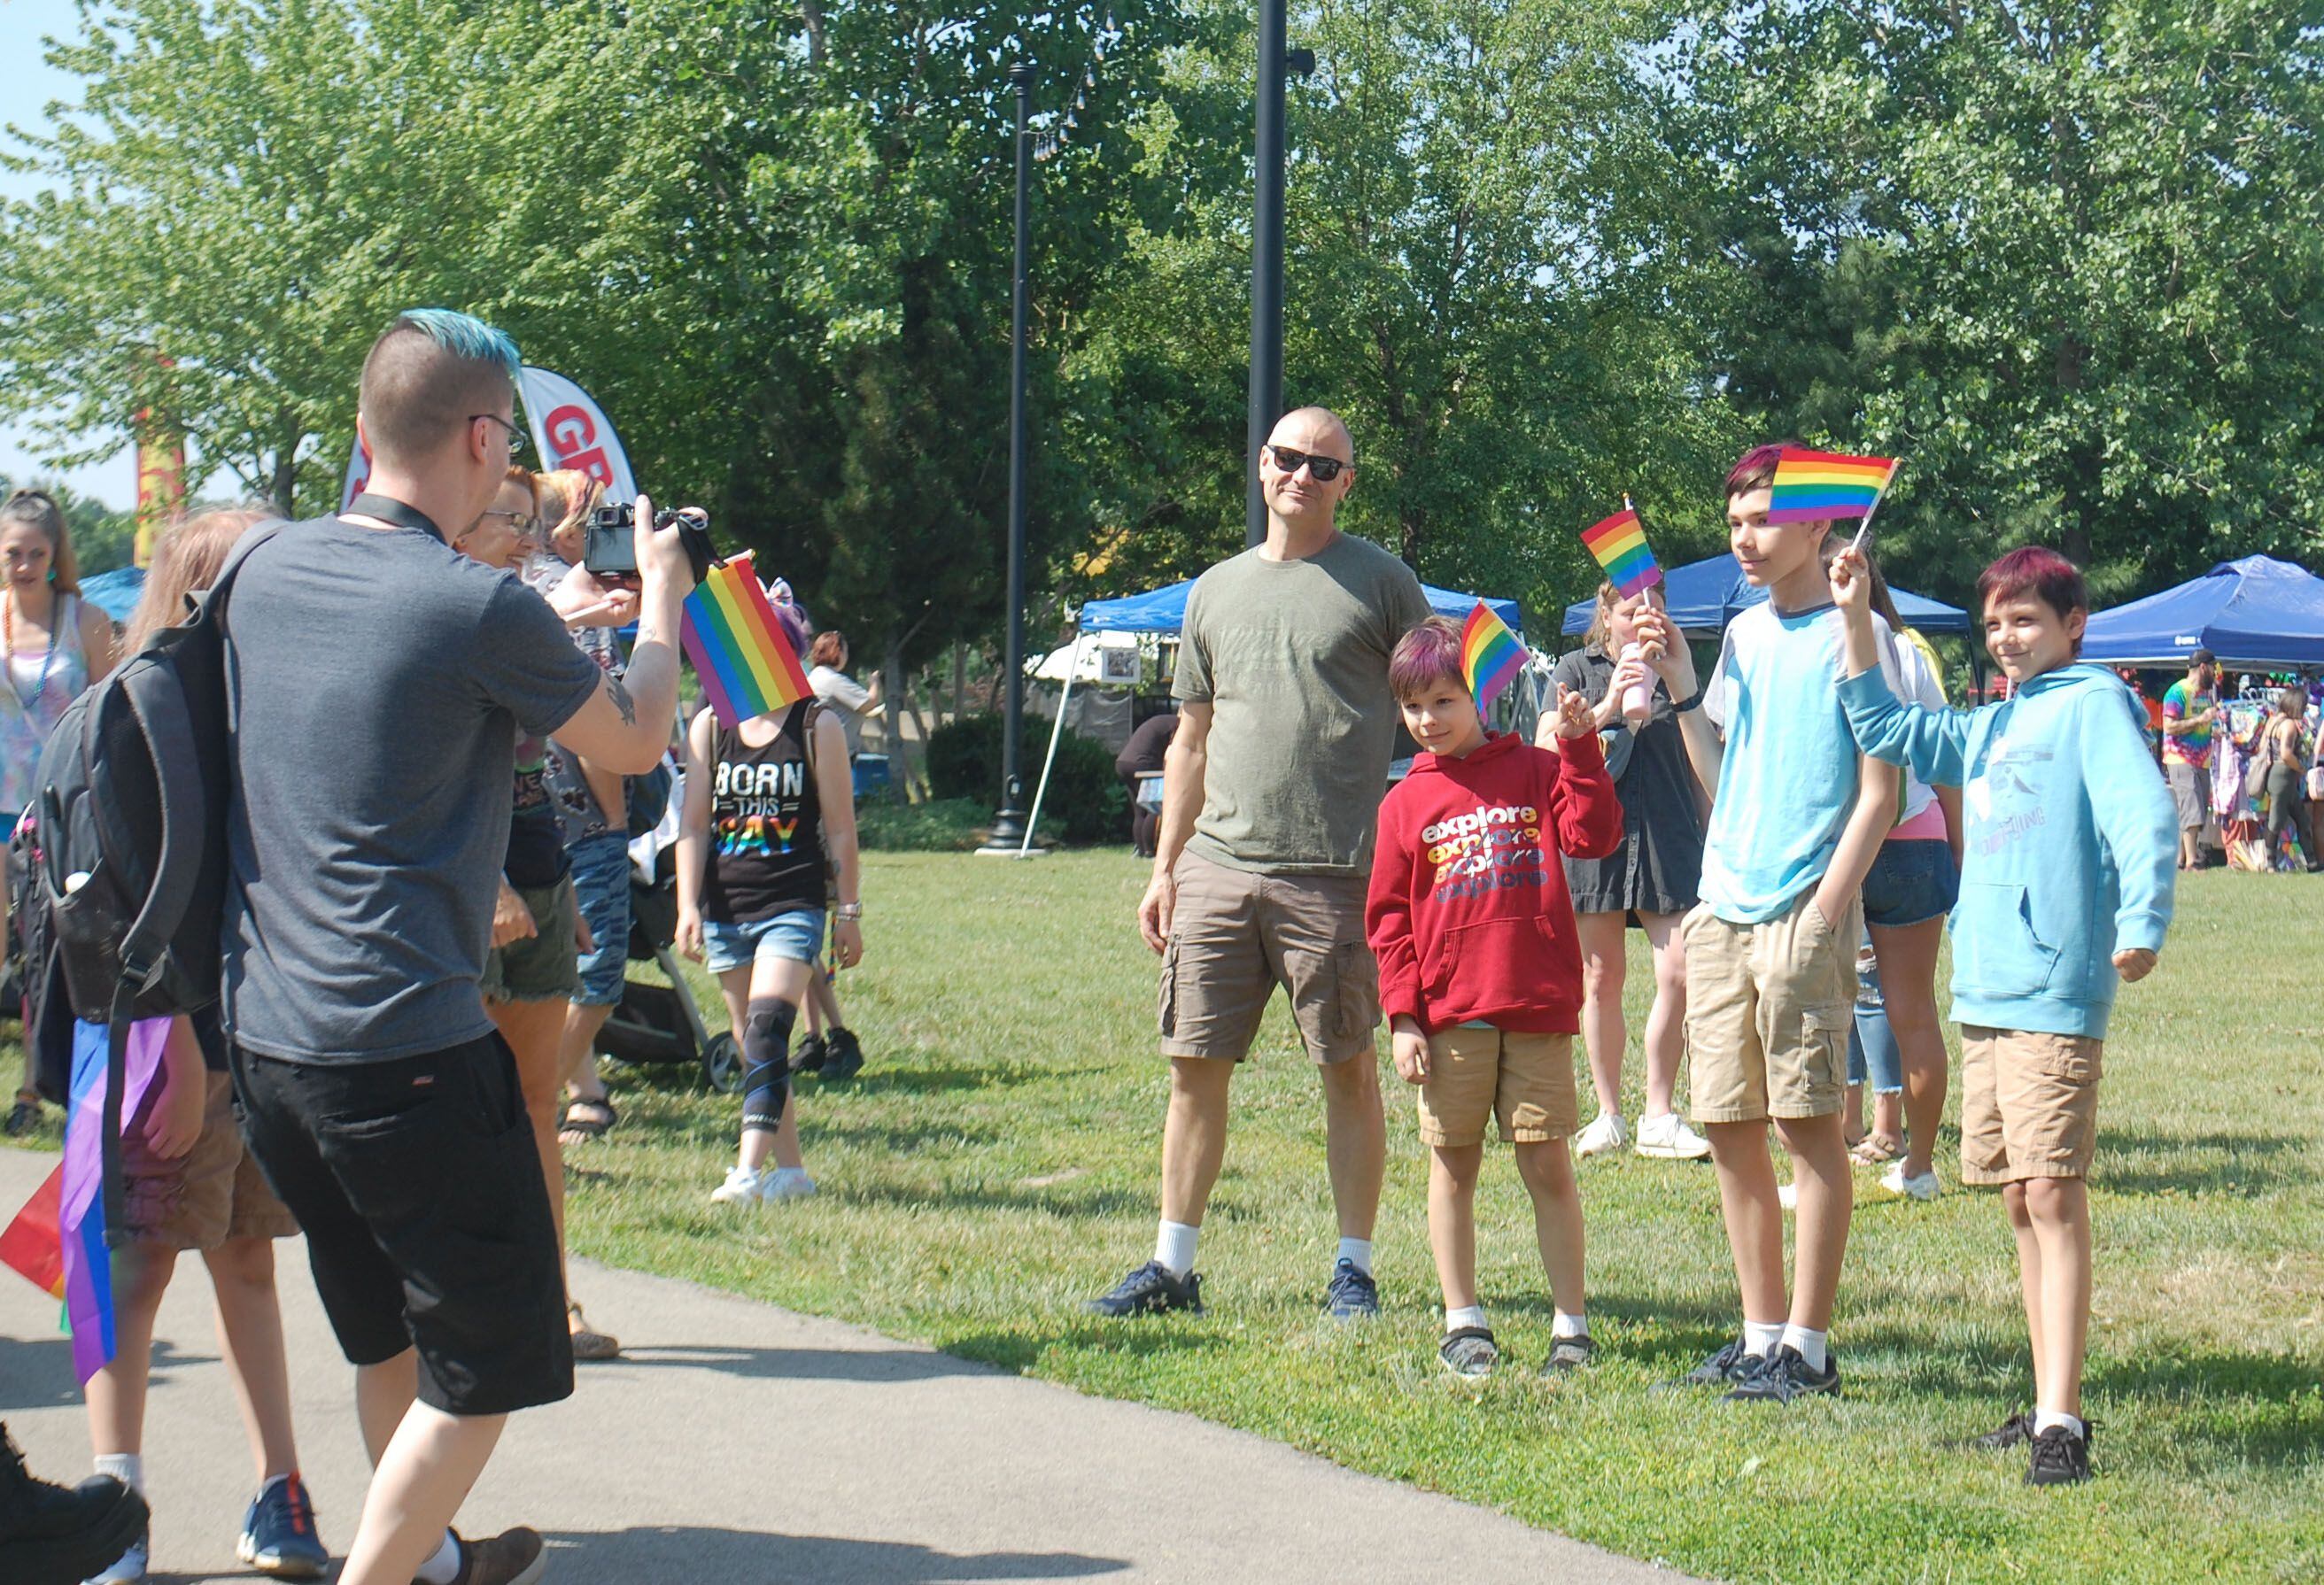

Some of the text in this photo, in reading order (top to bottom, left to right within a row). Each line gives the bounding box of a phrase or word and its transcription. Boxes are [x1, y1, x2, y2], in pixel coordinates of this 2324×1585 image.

[715, 762, 804, 797] BORN
[732, 797, 780, 816] THIS
[1422, 806, 1538, 844] explore
[715, 814, 799, 856] GAY
[1427, 826, 1542, 864] explore
[1434, 847, 1545, 885] explore
[1436, 870, 1549, 903] explore
